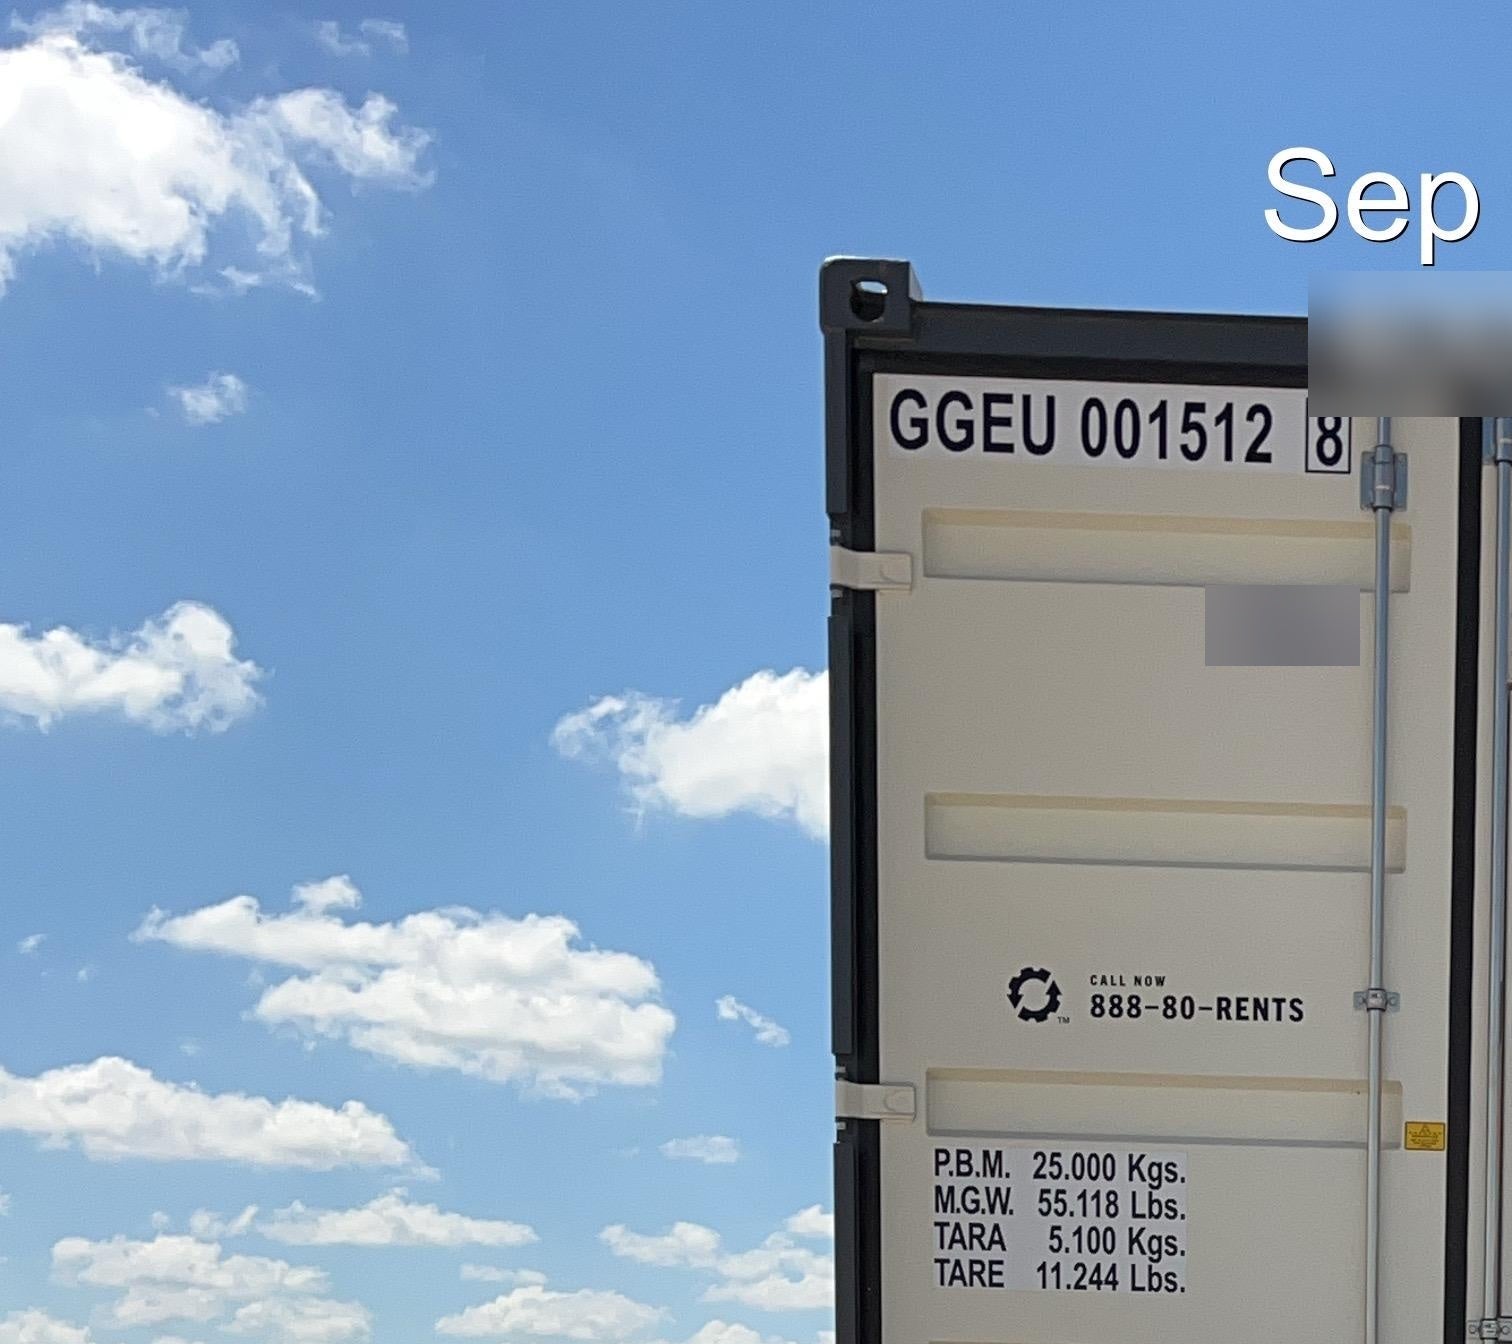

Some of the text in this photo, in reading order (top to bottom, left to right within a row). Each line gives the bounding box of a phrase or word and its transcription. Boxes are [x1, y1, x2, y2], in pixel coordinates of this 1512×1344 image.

[889, 388, 1056, 456] GGEU
[1080, 397, 1273, 464] 001512
[1090, 974, 1166, 987] CALL NOW
[1090, 993, 1304, 1023] 888-80-RENTS
[934, 1148, 1186, 1191] P.B.M. 25.000 Kgs.
[934, 1184, 1186, 1221] M.G.W. 55.118 Lbs.
[933, 1221, 1186, 1264] TARA 5.100 Kgs.
[933, 1257, 1186, 1293] TARE 11.244 Lbs.
